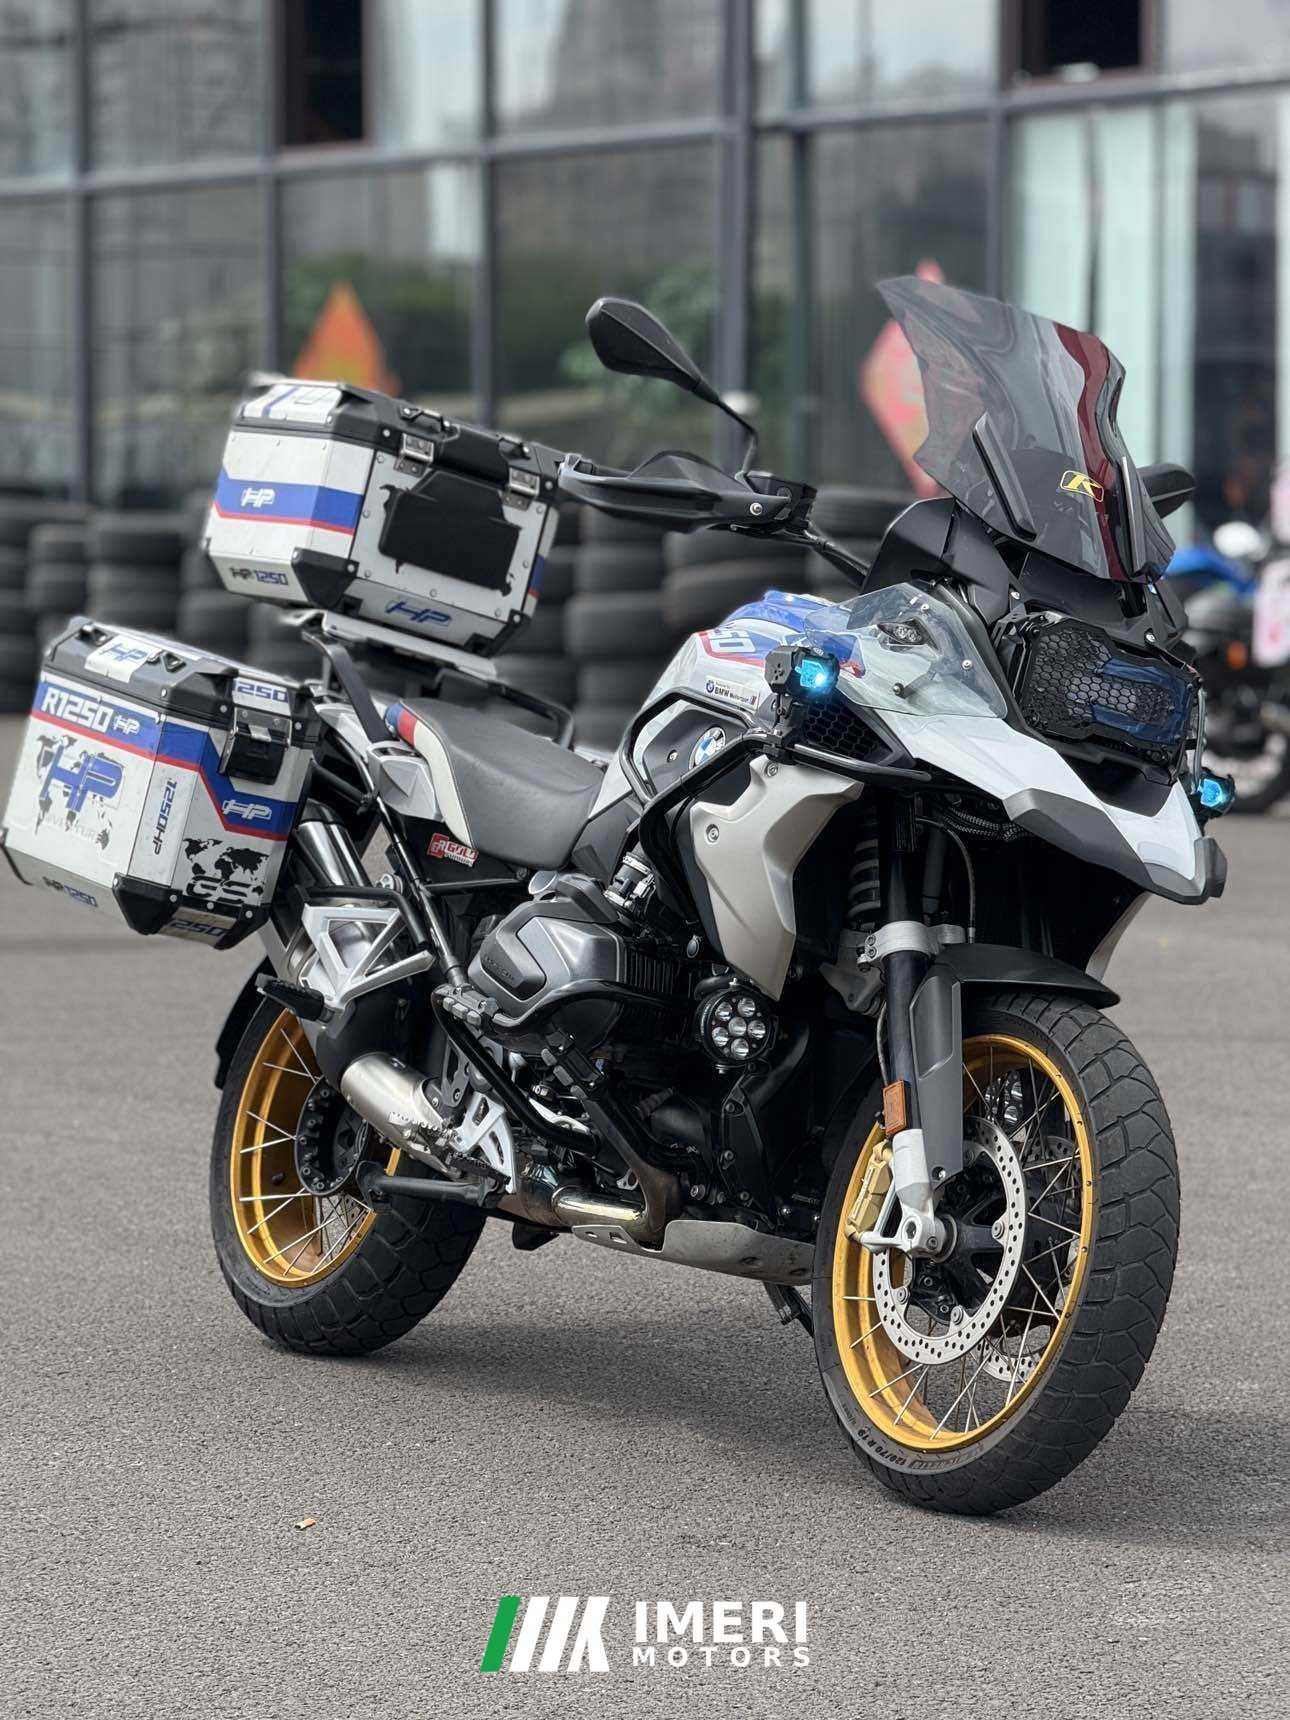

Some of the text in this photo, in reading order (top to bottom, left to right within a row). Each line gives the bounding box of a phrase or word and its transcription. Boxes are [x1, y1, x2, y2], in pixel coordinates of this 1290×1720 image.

[240, 487, 276, 508] HP
[384, 601, 453, 627] HP
[41, 687, 114, 733] R1250
[39, 743, 123, 814] HP
[222, 799, 272, 820] HP
